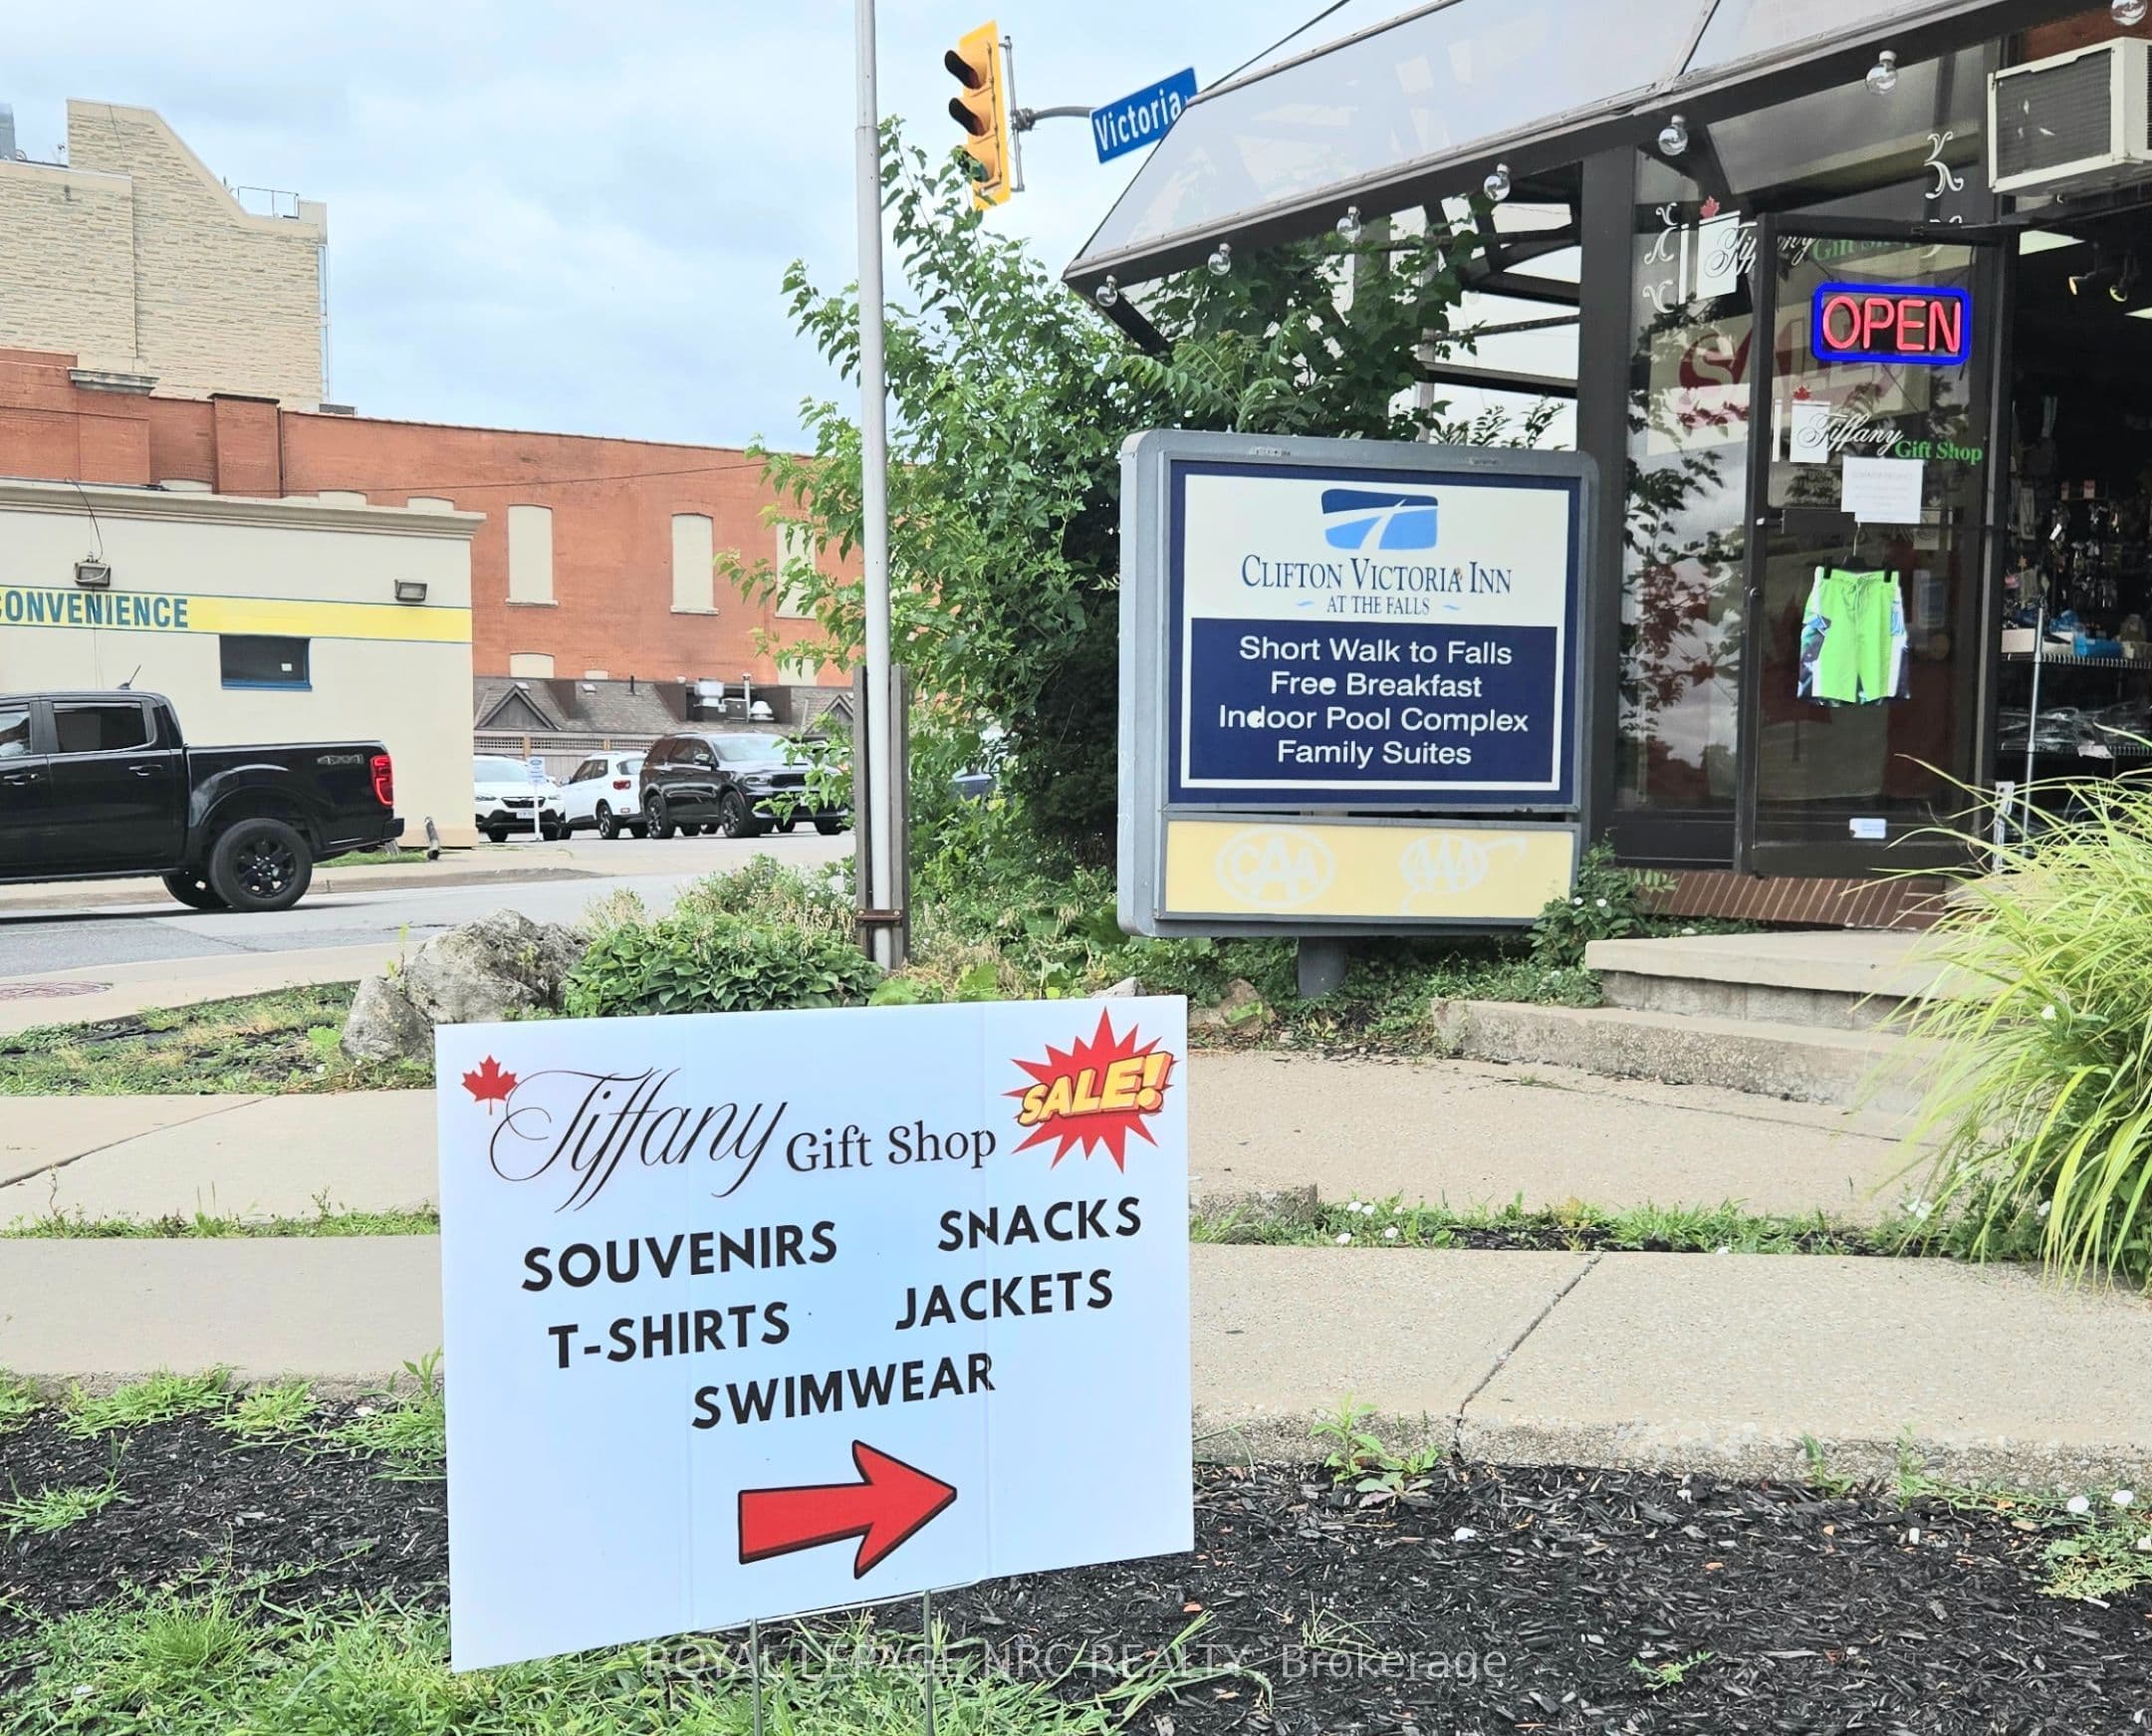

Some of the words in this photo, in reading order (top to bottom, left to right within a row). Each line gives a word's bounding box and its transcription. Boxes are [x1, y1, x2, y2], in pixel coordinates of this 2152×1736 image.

[1094, 88, 1182, 151] Victoria
[1704, 221, 1817, 279] Tifny
[1822, 295, 1961, 353] OPEN
[1796, 411, 1904, 456] Tiffany
[1895, 439, 1932, 458] Gift
[1936, 439, 1984, 465] Shop
[1242, 554, 1342, 589] CLIFTON
[1350, 558, 1462, 594] VICTORIA
[1469, 561, 1512, 595] INN
[0, 590, 188, 628] ONVENIENCE
[1326, 595, 1347, 614] AT
[1351, 595, 1382, 615] THE
[1386, 597, 1430, 616] FALLS
[1239, 635, 1320, 661] Short
[1329, 637, 1400, 662] Walk
[1409, 640, 1437, 663] to
[1448, 640, 1513, 665] Falls
[1271, 670, 1336, 695] Free
[1346, 672, 1482, 698] Breakfast
[1219, 704, 1316, 729] Indoor
[1326, 706, 1390, 730] Pool
[1400, 707, 1529, 737] Complex
[1278, 739, 1373, 769] Family
[1382, 740, 1472, 765] Suites
[1230, 835, 1318, 900] CAA
[1018, 1051, 1174, 1127] SALE!
[490, 1067, 789, 1213] Tiffany
[787, 1123, 872, 1172] Gift
[887, 1119, 996, 1169] Shop
[938, 1196, 1141, 1252] SNACKS
[521, 1220, 837, 1292] SOUVENIRS
[894, 1268, 1112, 1331] JACKETS
[548, 1301, 790, 1368] T-SHIRTS
[691, 1353, 996, 1430] SWIMWEAR
